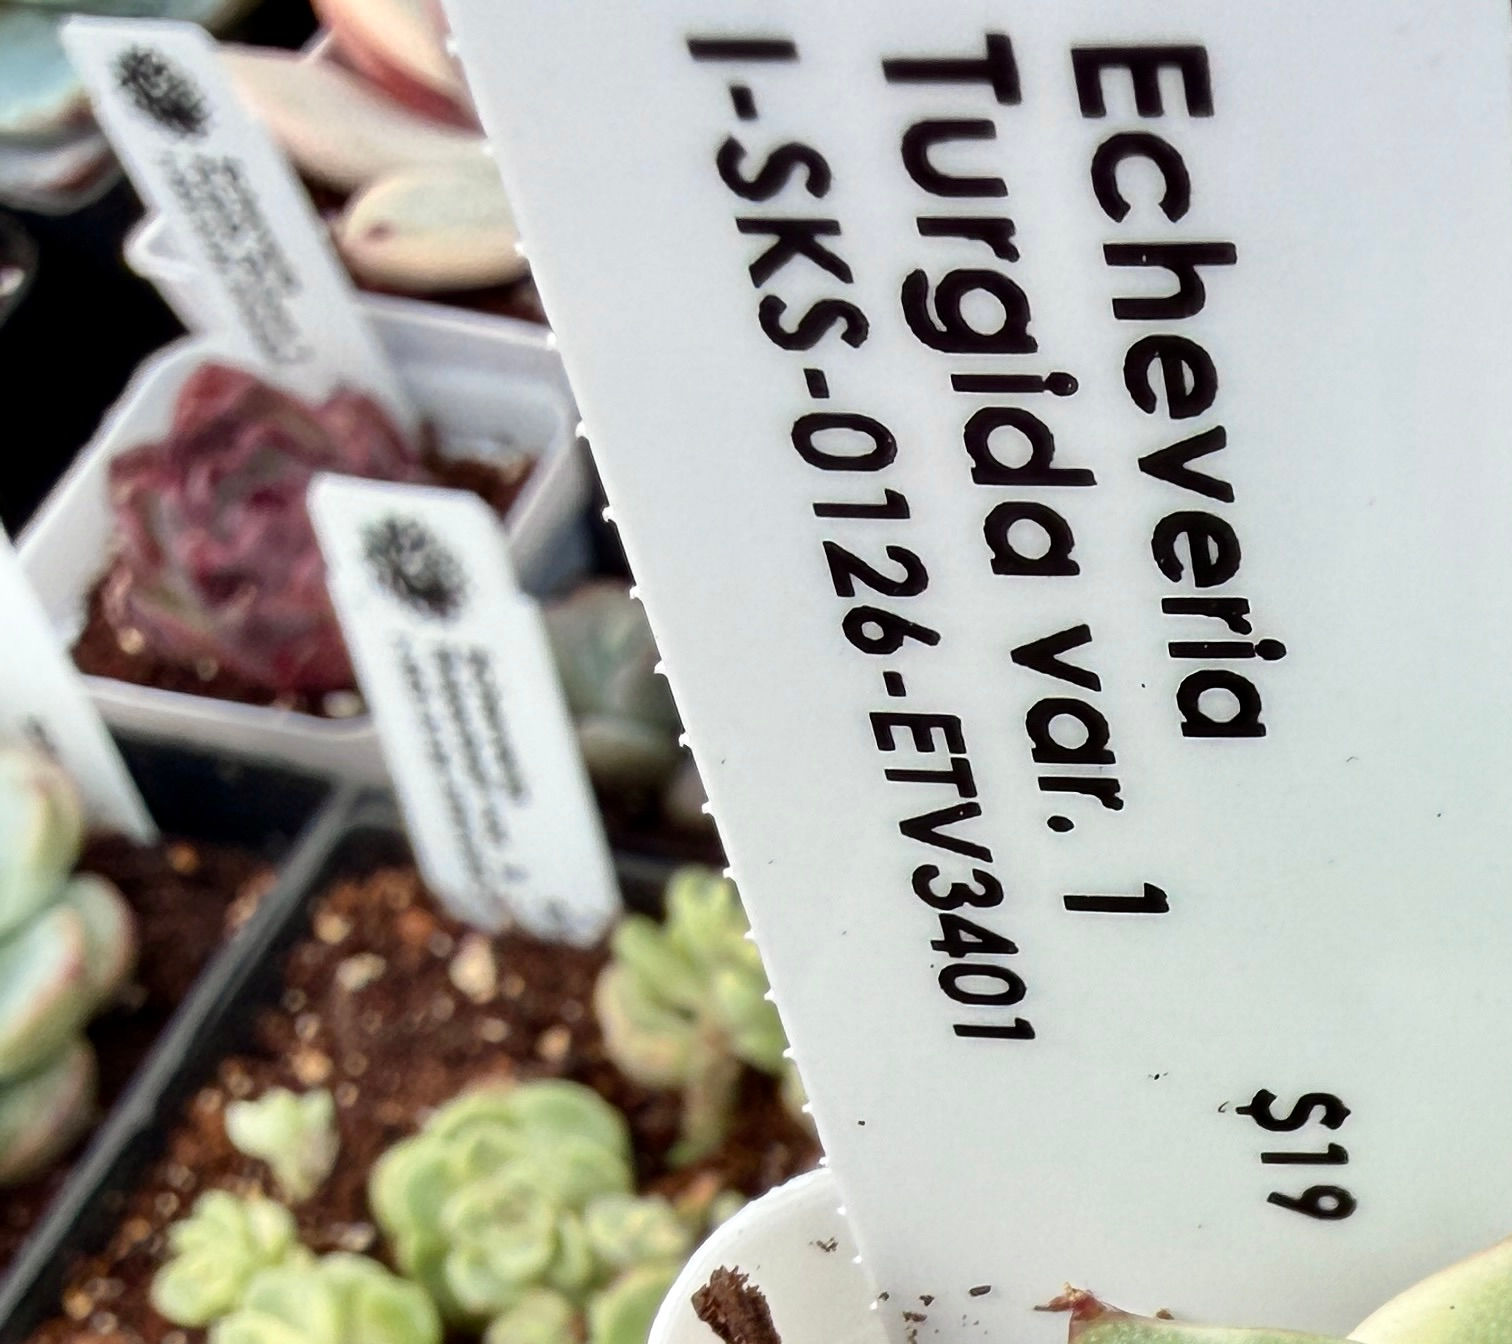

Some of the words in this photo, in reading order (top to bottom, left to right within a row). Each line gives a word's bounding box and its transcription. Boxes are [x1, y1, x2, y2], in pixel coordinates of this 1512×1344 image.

[882, 34, 1097, 576] Turgida
[1071, 45, 1286, 737] Echeveria
[688, 39, 1035, 1039] I-SKS-0126-ETV3401
[1011, 624, 1123, 832] var.
[1064, 883, 1169, 913] 1
[1236, 1089, 1356, 1220] $19
